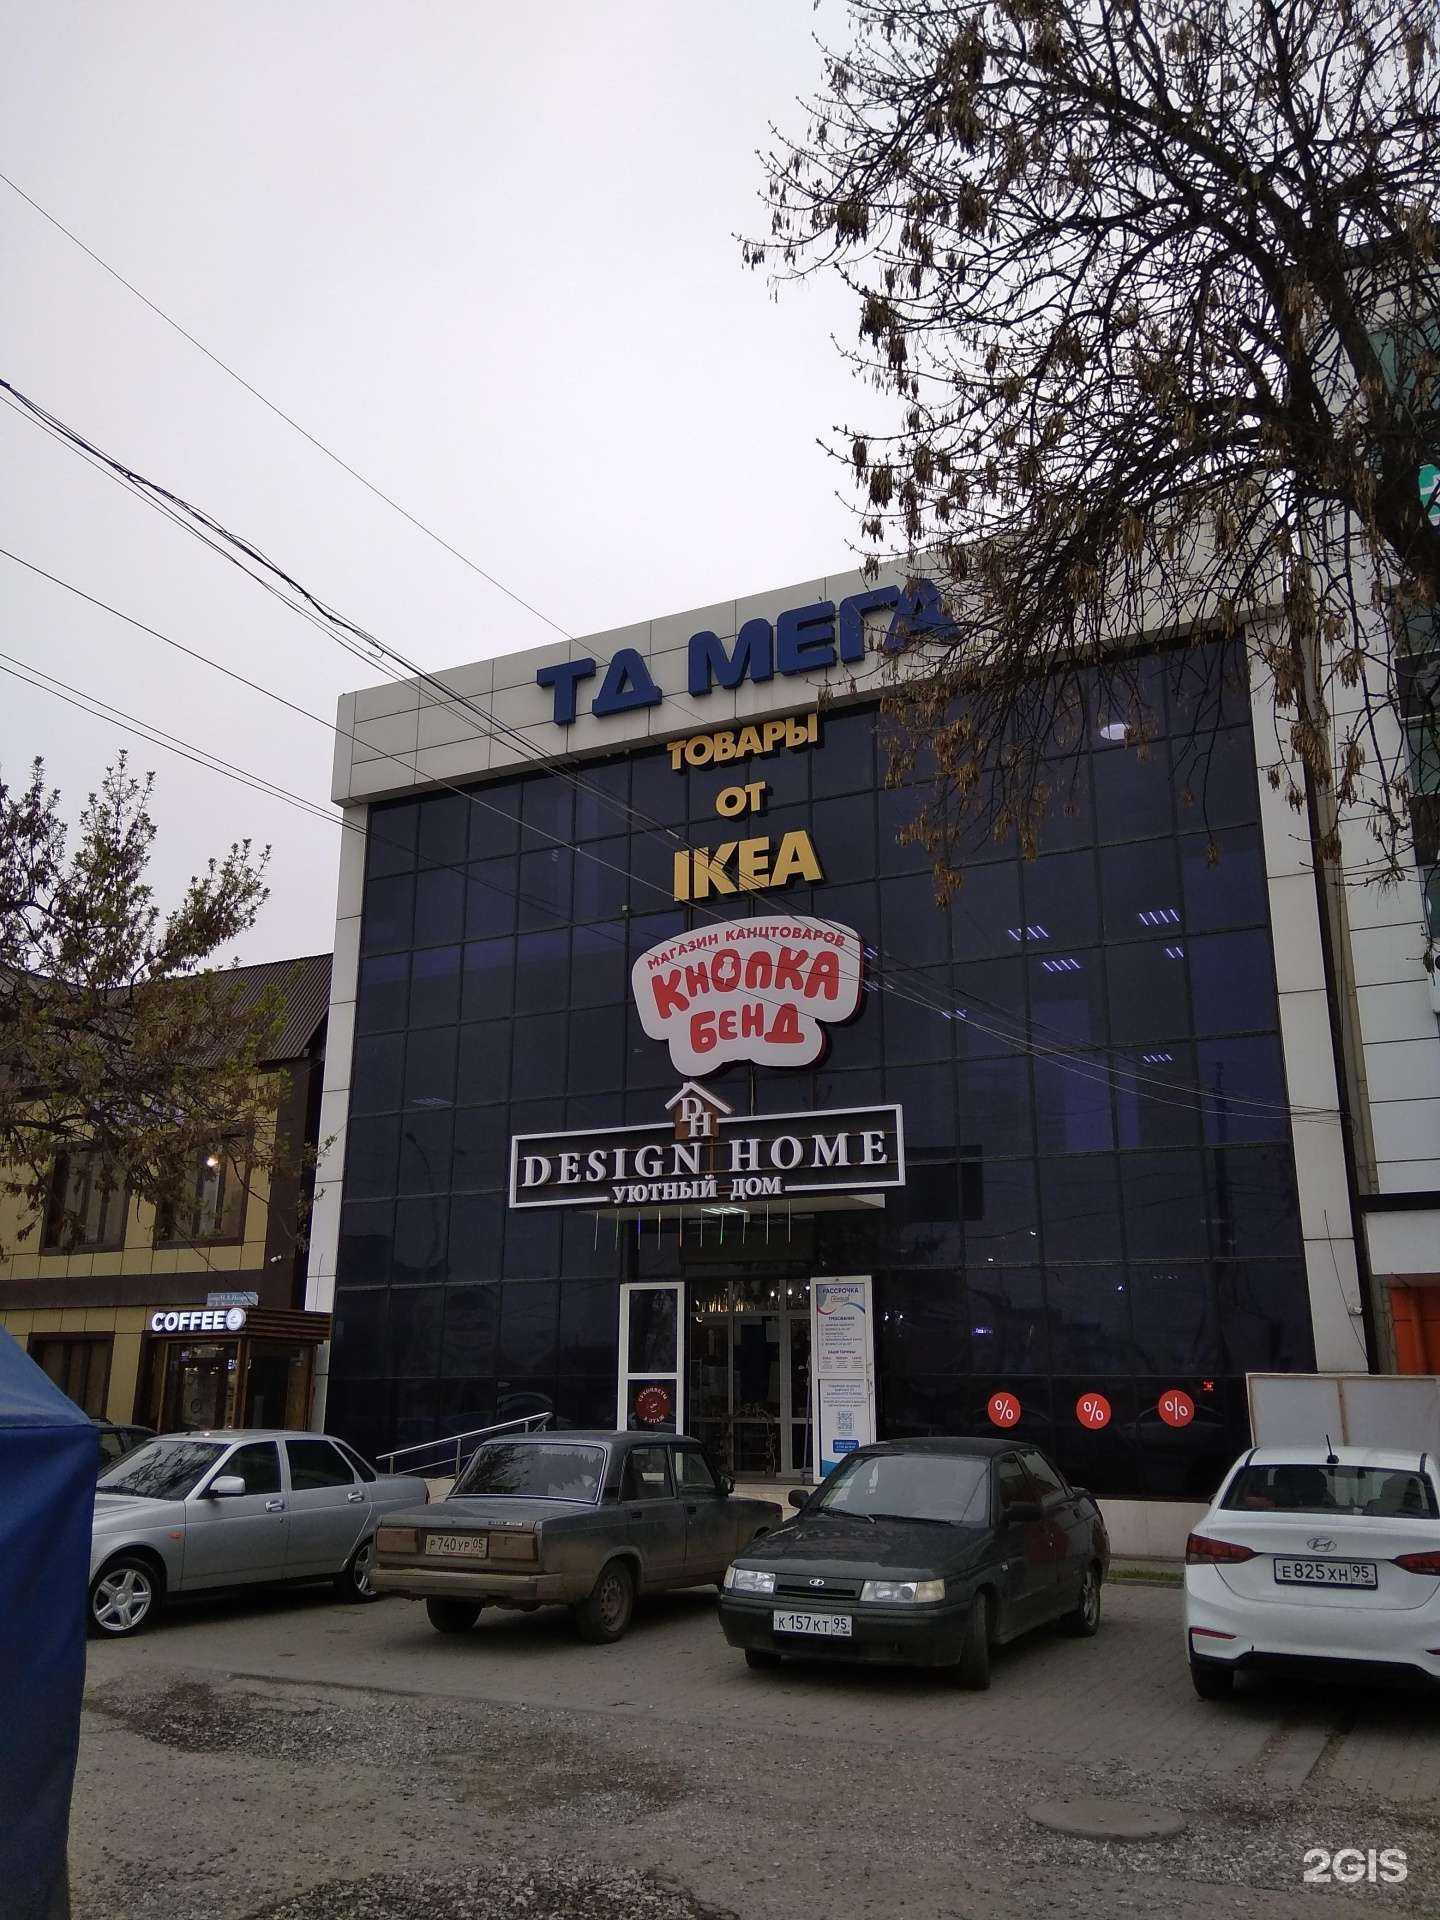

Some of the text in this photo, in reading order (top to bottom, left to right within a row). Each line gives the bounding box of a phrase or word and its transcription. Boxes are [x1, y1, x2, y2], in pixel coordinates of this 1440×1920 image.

[537, 577, 963, 726] ТД МЕГА
[667, 713, 819, 771] ТОВАРЫ
[716, 781, 767, 818] ОТ
[674, 830, 824, 903] IKEA
[647, 926, 846, 970] МАГАЗИН КАНЦТОВАРОВ
[651, 946, 840, 1019] КНОПКА
[690, 1003, 805, 1054] БЕНД
[521, 1130, 888, 1187] DESIGN HOME
[612, 1174, 785, 1204] УЮТНЫЙ ДОМ
[822, 1287, 859, 1295] РАССРОЧКА
[151, 1311, 226, 1332] COFFEE
